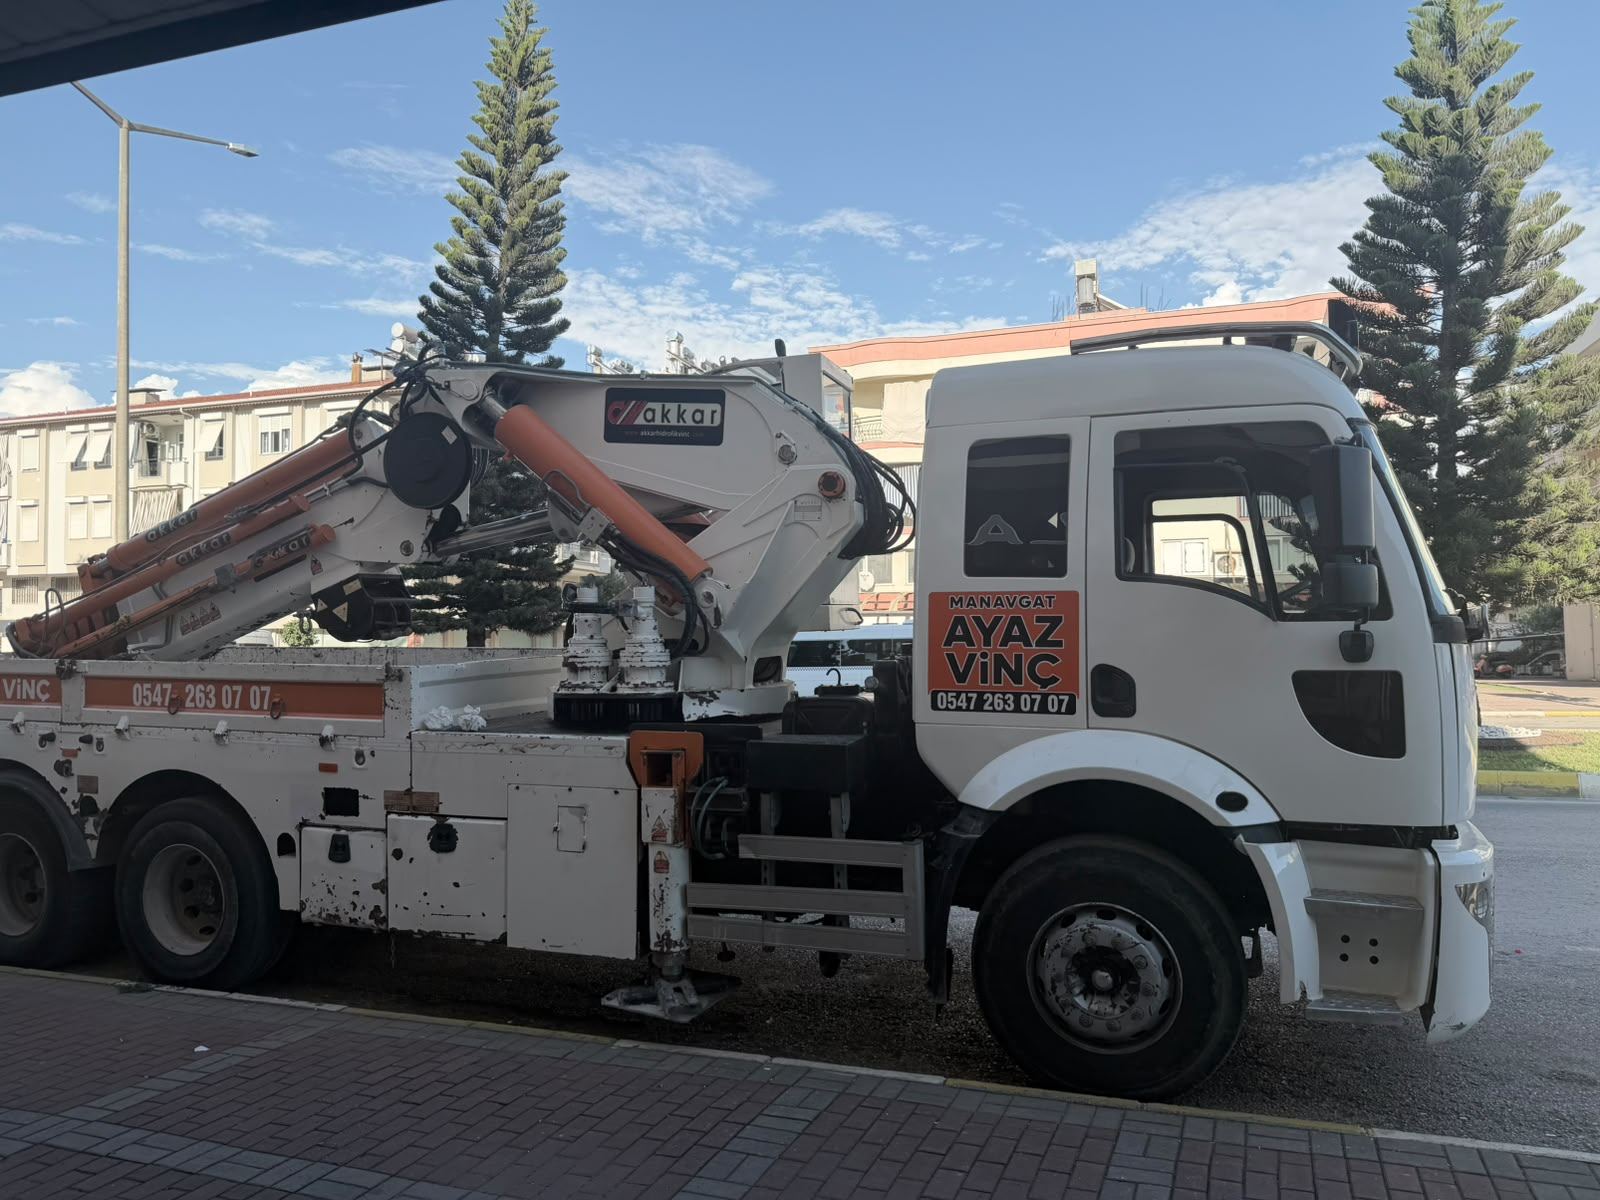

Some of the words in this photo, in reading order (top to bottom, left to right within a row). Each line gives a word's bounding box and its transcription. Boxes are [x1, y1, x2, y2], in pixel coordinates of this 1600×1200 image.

[643, 404, 717, 424] akkar
[147, 509, 197, 542] akkar
[177, 533, 230, 563] akkar
[949, 595, 1056, 609] MANAVGAT
[942, 615, 1064, 648] AYAZ
[132, 683, 172, 706] 0547
[185, 684, 216, 709] 263
[222, 685, 242, 709] 07
[250, 685, 271, 710] 07
[937, 692, 977, 710] 0547
[983, 693, 1015, 711] 263
[1020, 694, 1041, 711] 07
[1048, 695, 1069, 712] 07
